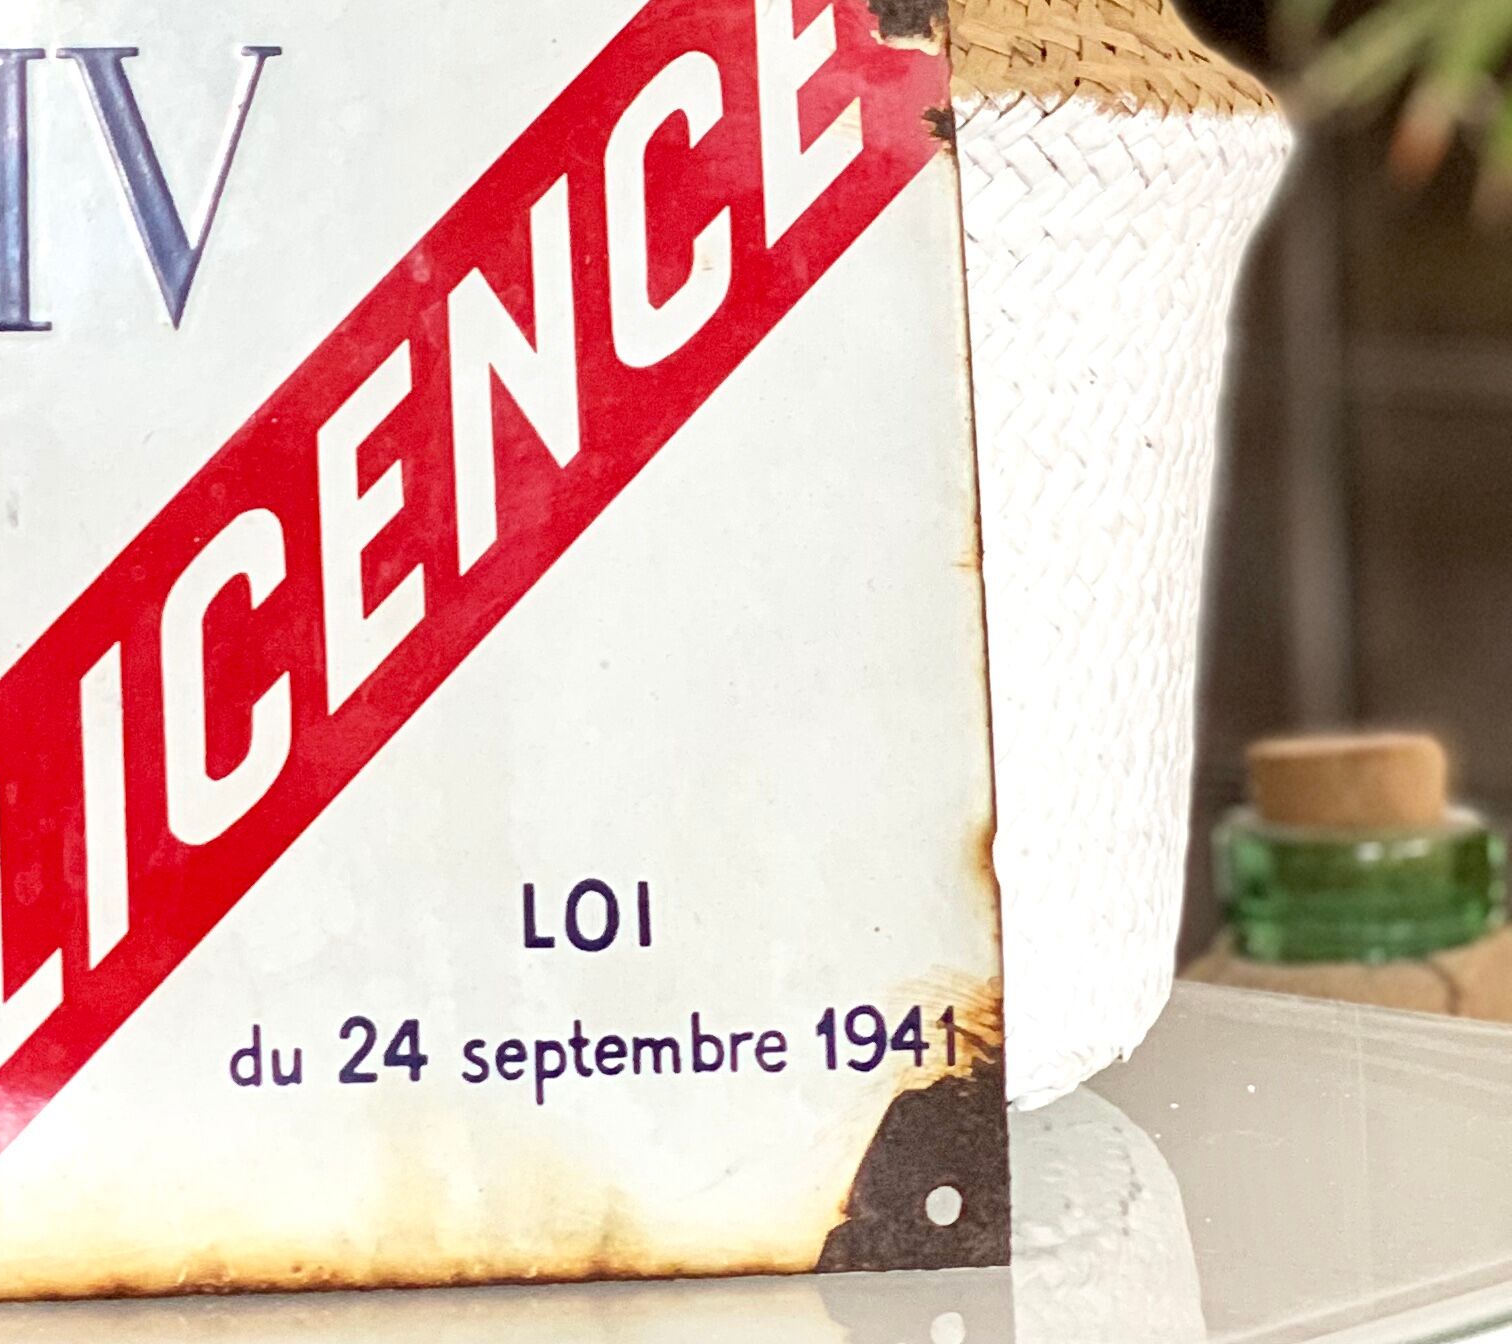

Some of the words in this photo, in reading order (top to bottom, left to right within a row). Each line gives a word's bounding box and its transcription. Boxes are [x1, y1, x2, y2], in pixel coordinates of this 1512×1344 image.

[521, 876, 654, 952] LOI
[228, 1023, 304, 1088] du
[336, 1016, 429, 1085] 24
[460, 1012, 788, 1106] septembre
[813, 1003, 962, 1075] 1941
